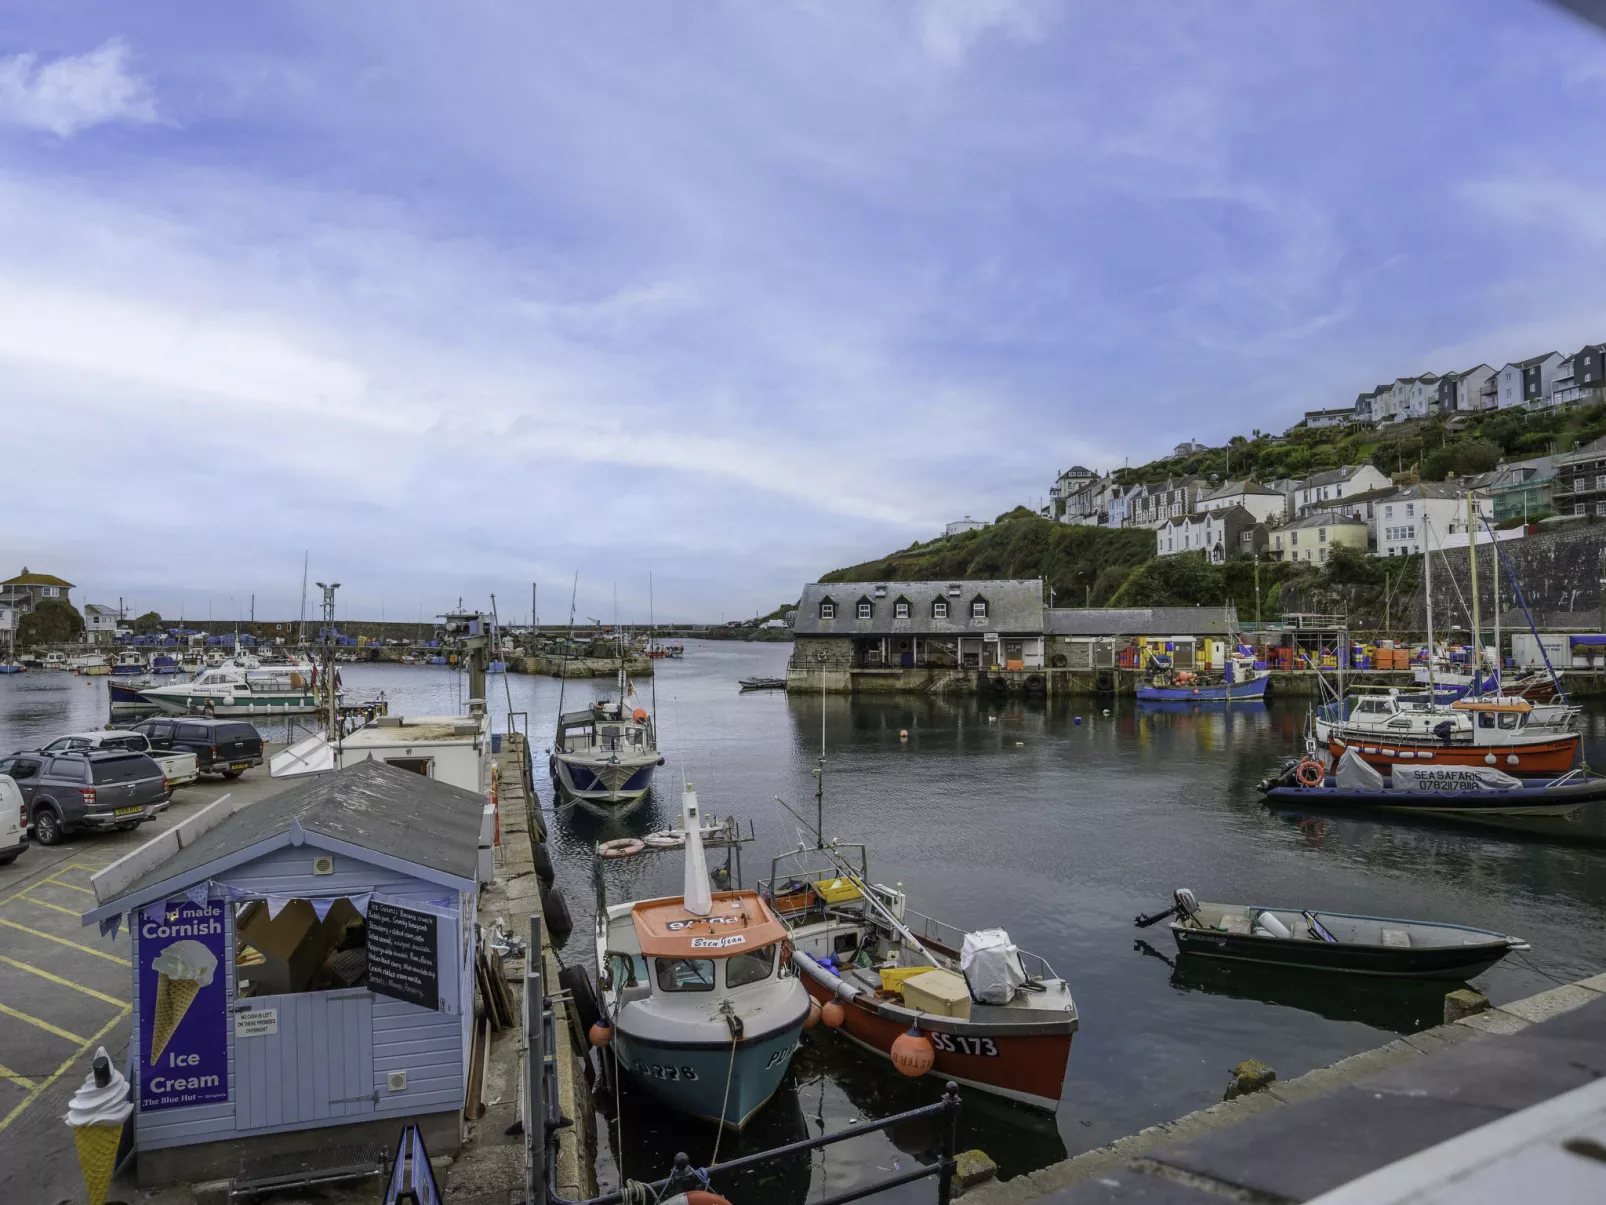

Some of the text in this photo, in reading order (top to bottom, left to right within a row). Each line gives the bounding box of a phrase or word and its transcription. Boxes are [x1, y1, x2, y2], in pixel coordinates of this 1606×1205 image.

[1414, 770, 1482, 781] SEA SAFARIS
[183, 906, 220, 918] made
[142, 918, 222, 939] Cornish
[694, 937, 743, 948] Bren Jean
[246, 1026, 268, 1034] OVERNIGHT
[931, 1032, 998, 1056] SS 173
[169, 1052, 200, 1068] Ice
[150, 1074, 219, 1094] Cream
[143, 1098, 159, 1106] The
[161, 1096, 180, 1104] Blue
[181, 1094, 196, 1102] Hut
